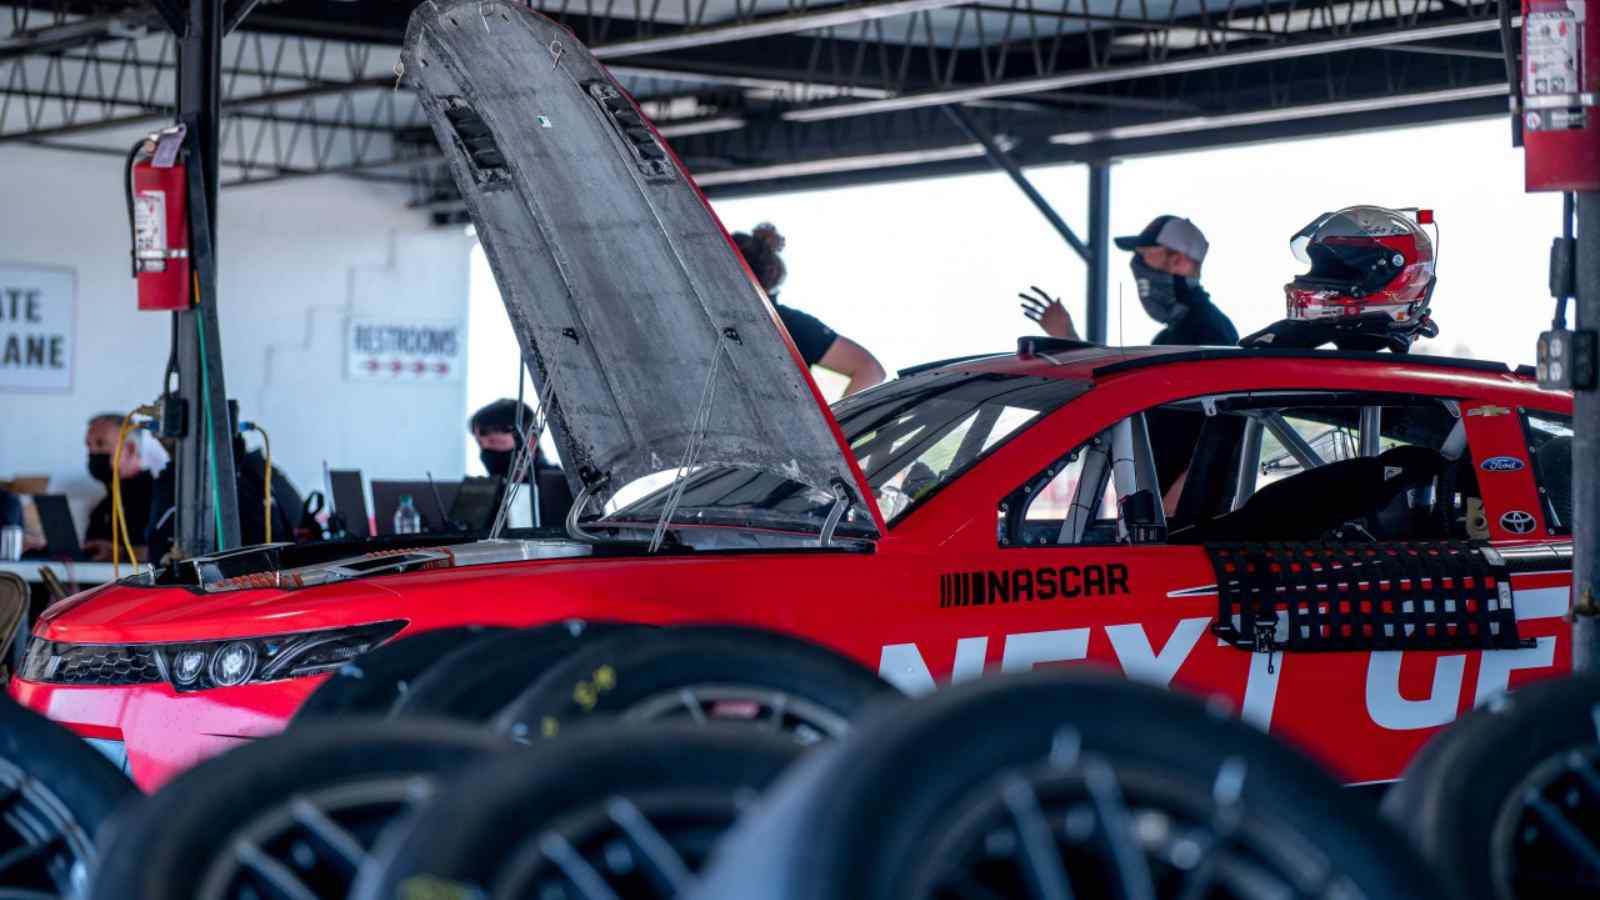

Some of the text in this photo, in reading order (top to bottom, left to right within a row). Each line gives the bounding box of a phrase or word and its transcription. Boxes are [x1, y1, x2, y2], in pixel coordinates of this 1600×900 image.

[0, 333, 66, 370] ANE
[354, 324, 458, 356] RESTROOMS
[987, 562, 1131, 605] NASCAR
